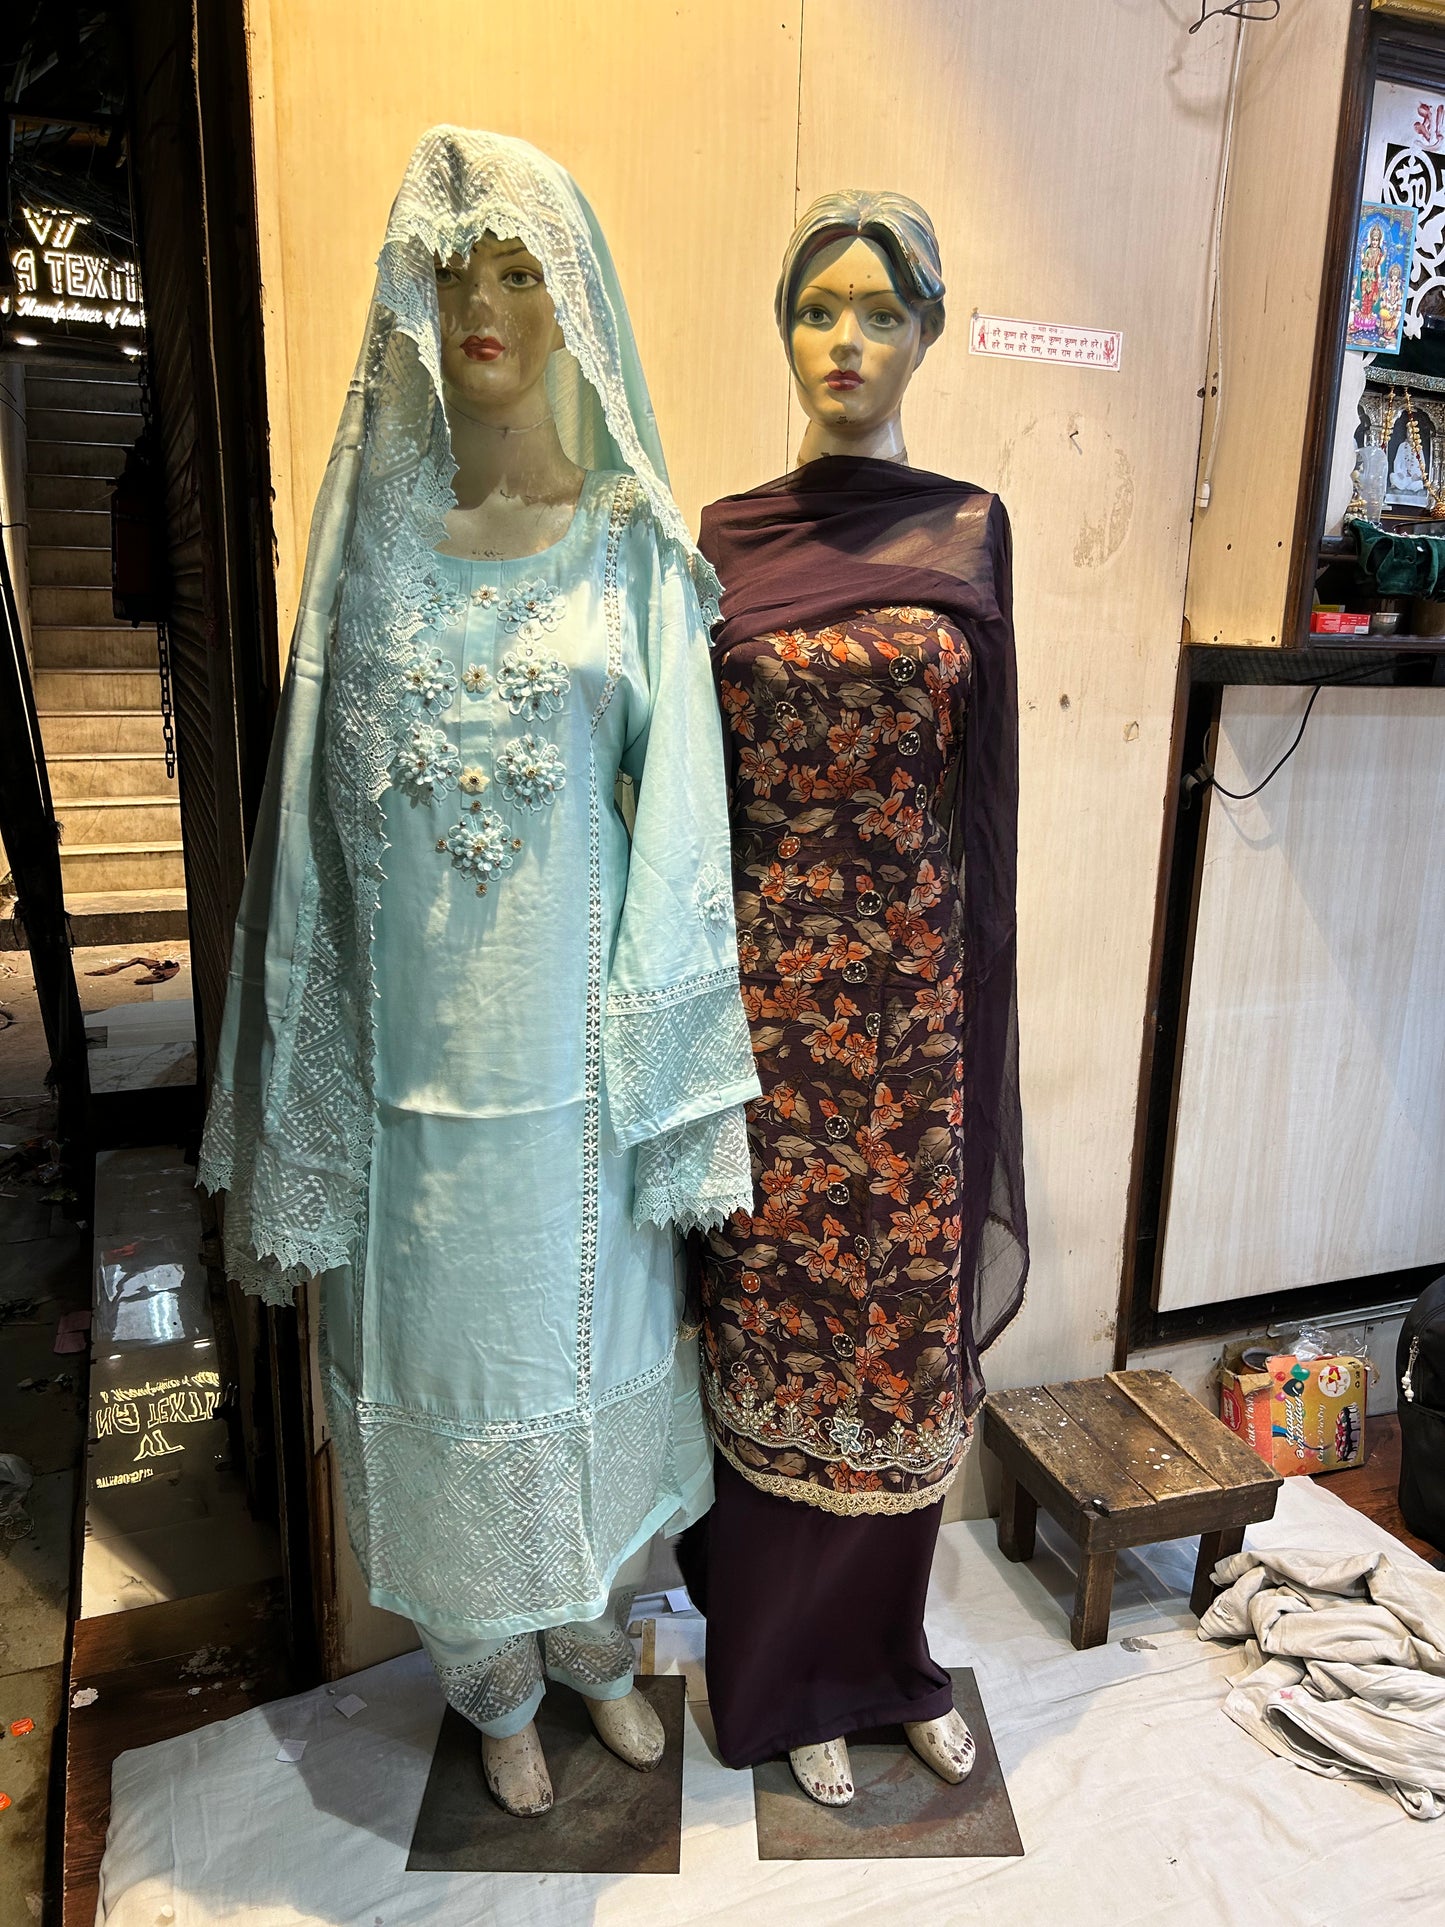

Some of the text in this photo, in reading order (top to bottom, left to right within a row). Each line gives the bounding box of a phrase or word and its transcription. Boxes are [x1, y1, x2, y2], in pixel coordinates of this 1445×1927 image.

[44, 250, 143, 303] TEXTI
[105, 306, 122, 329] of
[992, 328, 1001, 337] हरे
[1003, 330, 1017, 341] कृष्ण
[1020, 330, 1028, 340] हरे
[1049, 336, 1062, 345] कृष्ण
[1064, 338, 1077, 348] कृष्ण
[1080, 337, 1088, 347] हरे
[992, 339, 1000, 349] हरे
[1004, 342, 1014, 351] राम
[1018, 342, 1027, 352] हरे
[1047, 347, 1057, 356] राम
[1061, 349, 1071, 357] राम
[1075, 348, 1083, 359] हरे
[1284, 1398, 1295, 1446] Happy
[1292, 1387, 1305, 1459] Birthday!
[1316, 1403, 1327, 1435] Pastry
[1246, 1423, 1257, 1447] Cake
